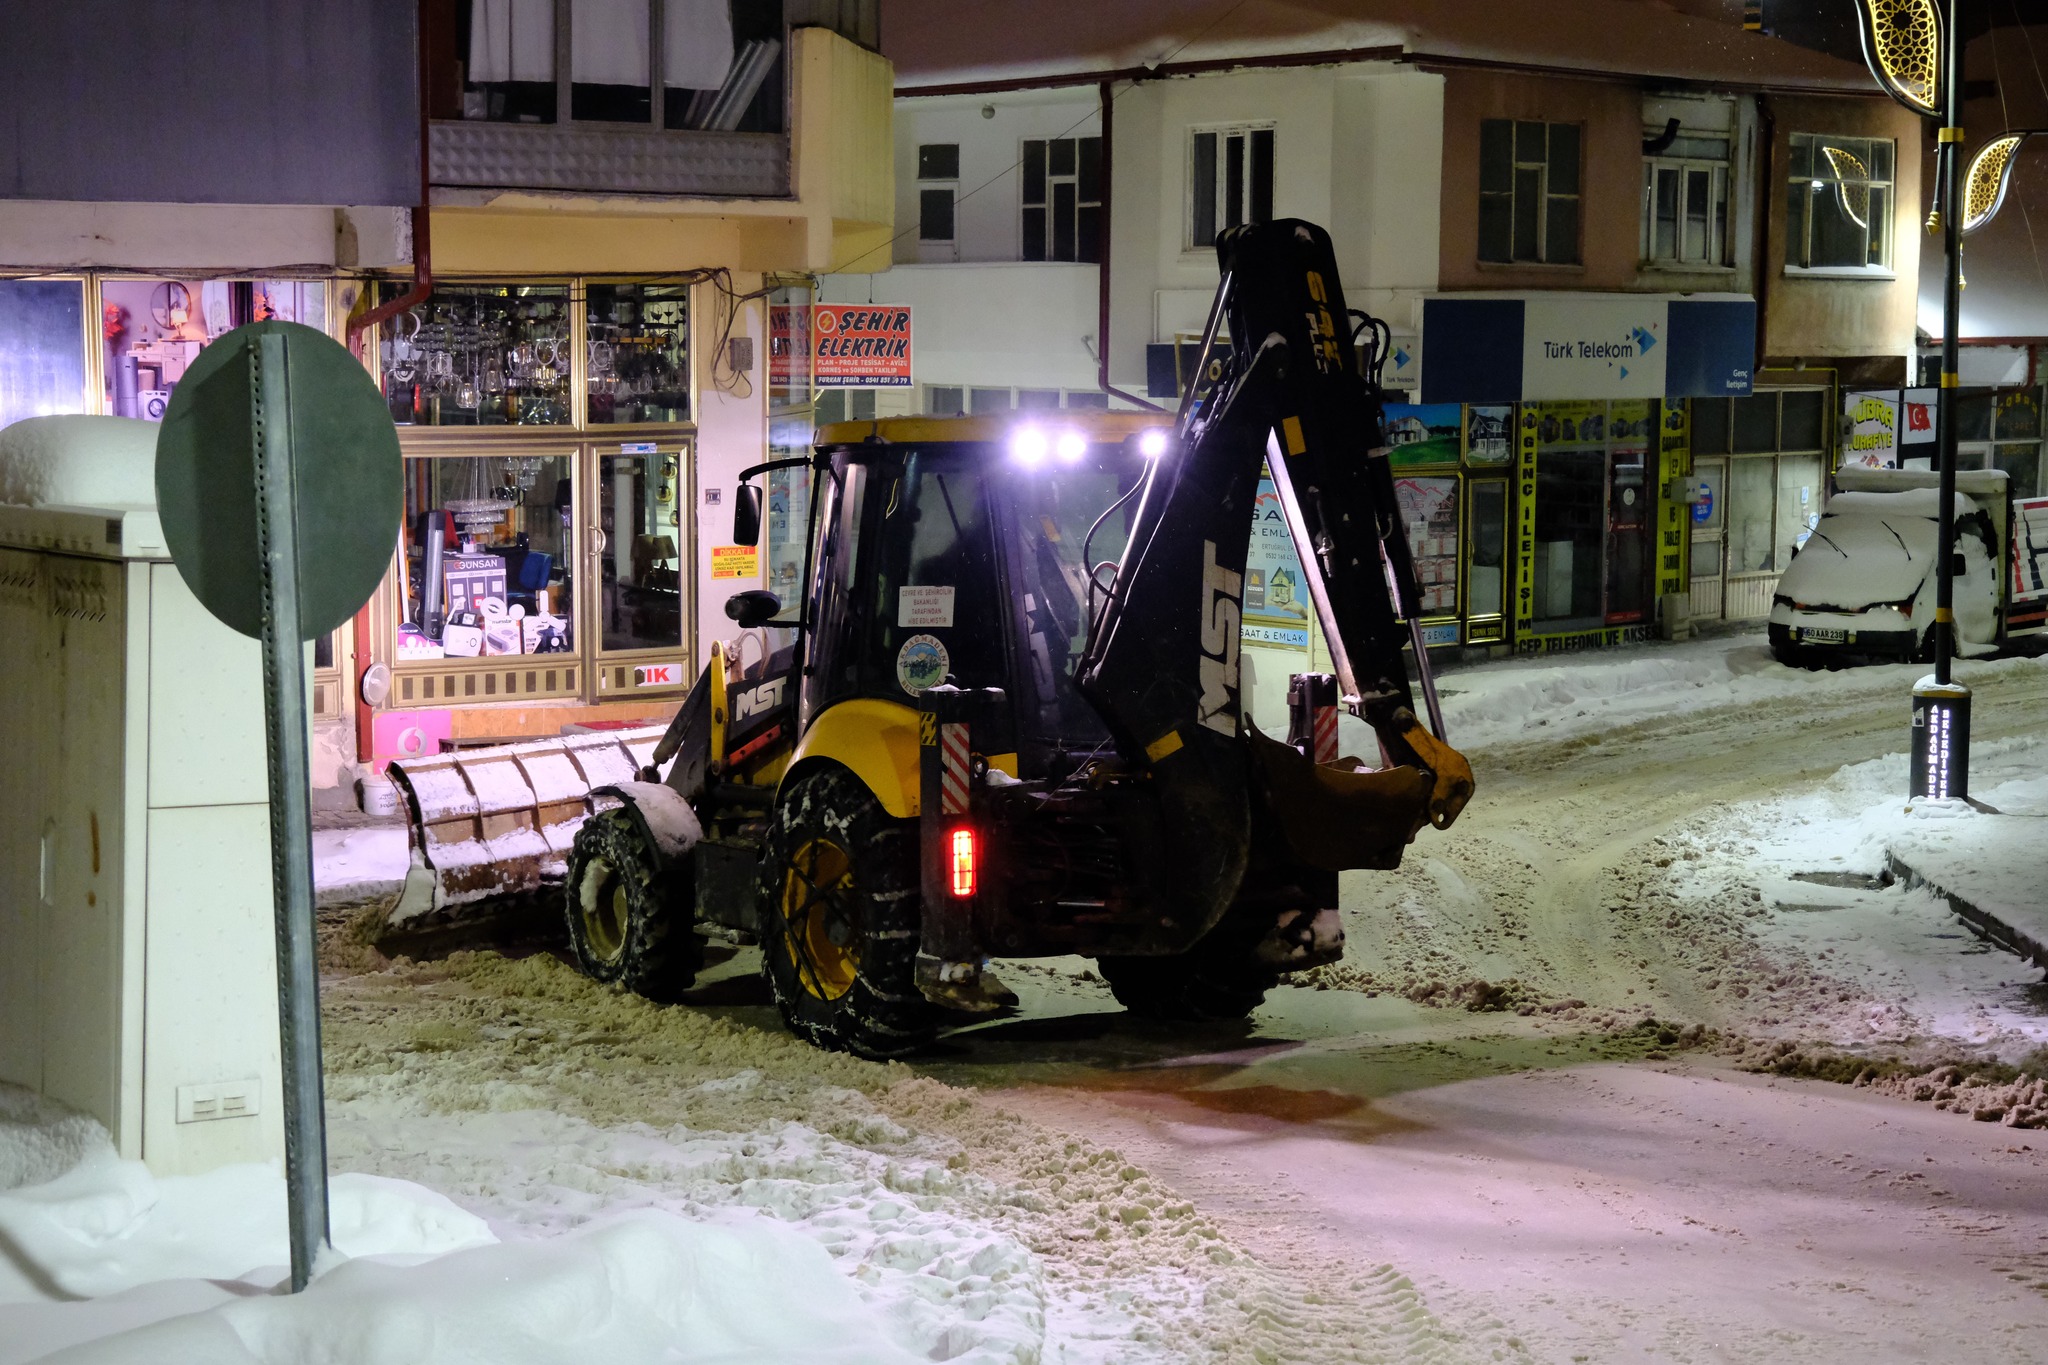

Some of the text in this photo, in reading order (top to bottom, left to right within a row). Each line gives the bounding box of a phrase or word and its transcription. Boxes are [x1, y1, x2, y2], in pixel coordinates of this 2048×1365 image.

[838, 310, 909, 335] ŞEHİR
[817, 334, 908, 358] ELEKTRİK
[1544, 341, 1633, 359] Türk Telekom
[860, 358, 885, 366] TESİSAT
[842, 375, 860, 384] ŞEHİR
[1733, 369, 1748, 379] Genç
[1726, 380, 1748, 389] İletişim
[1848, 431, 1893, 451] UHAFİYE
[1522, 436, 1534, 498] GENÇ
[1517, 506, 1532, 630] İLETİŞİM
[1197, 539, 1242, 738] MST
[1263, 630, 1269, 640] &
[1273, 632, 1304, 642] EMLAK
[1605, 629, 1619, 646] VE
[1816, 629, 1829, 638] AAR
[1830, 630, 1843, 639] 238
[735, 676, 787, 722] MST
